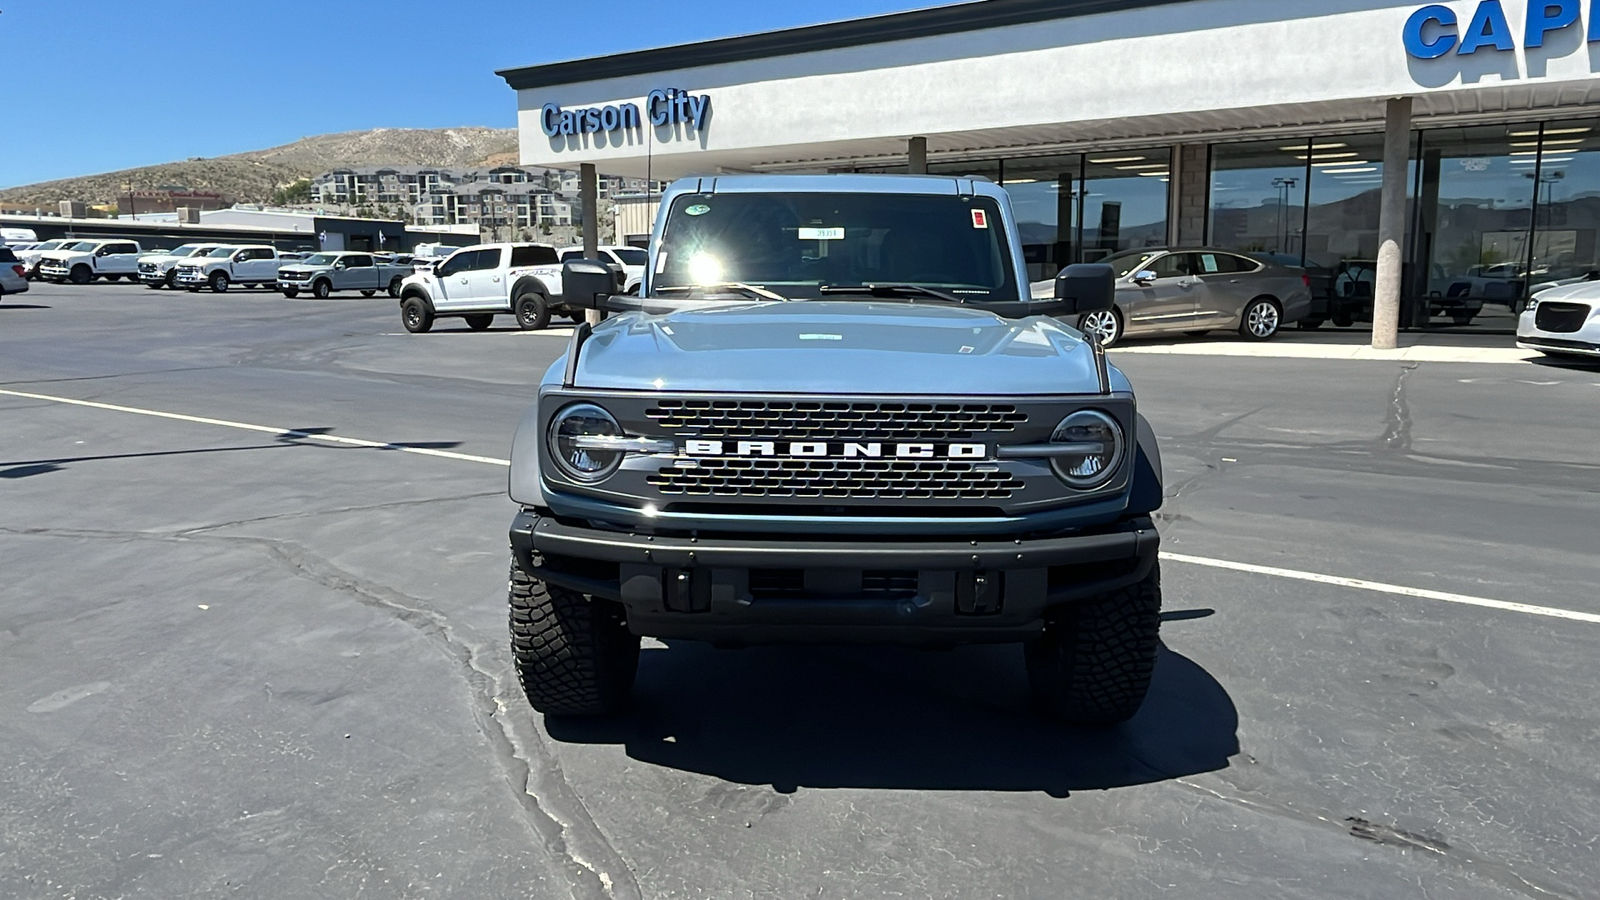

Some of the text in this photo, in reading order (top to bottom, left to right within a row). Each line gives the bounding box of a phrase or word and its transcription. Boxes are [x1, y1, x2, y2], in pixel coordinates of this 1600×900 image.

[540, 87, 713, 138] Carson City
[685, 440, 986, 458] BRONCO
